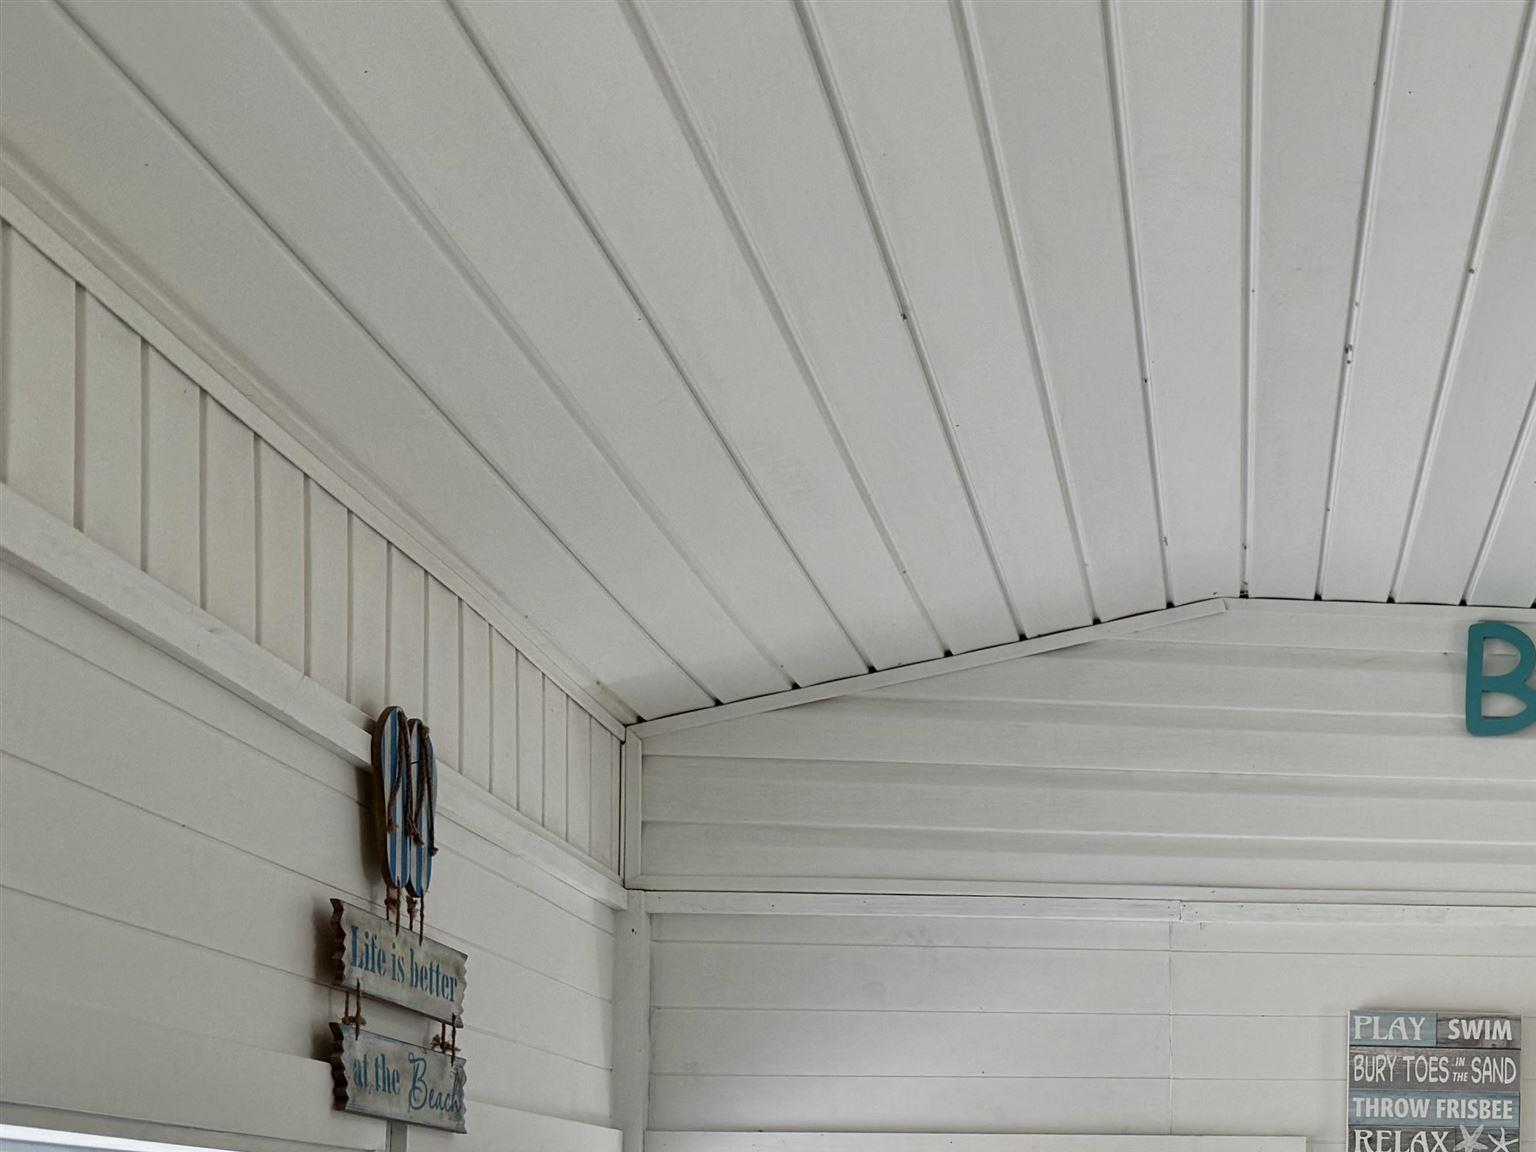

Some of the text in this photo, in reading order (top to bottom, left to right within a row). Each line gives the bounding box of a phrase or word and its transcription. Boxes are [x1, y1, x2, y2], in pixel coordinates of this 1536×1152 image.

[351, 925, 458, 1002] Life is better
[1354, 1015, 1513, 1041] PLAY SWIM
[354, 1052, 462, 1113] at the Beach
[1353, 1054, 1517, 1085] BURY TOES IN THE SAND
[1352, 1097, 1513, 1120] THROW FRISBEE
